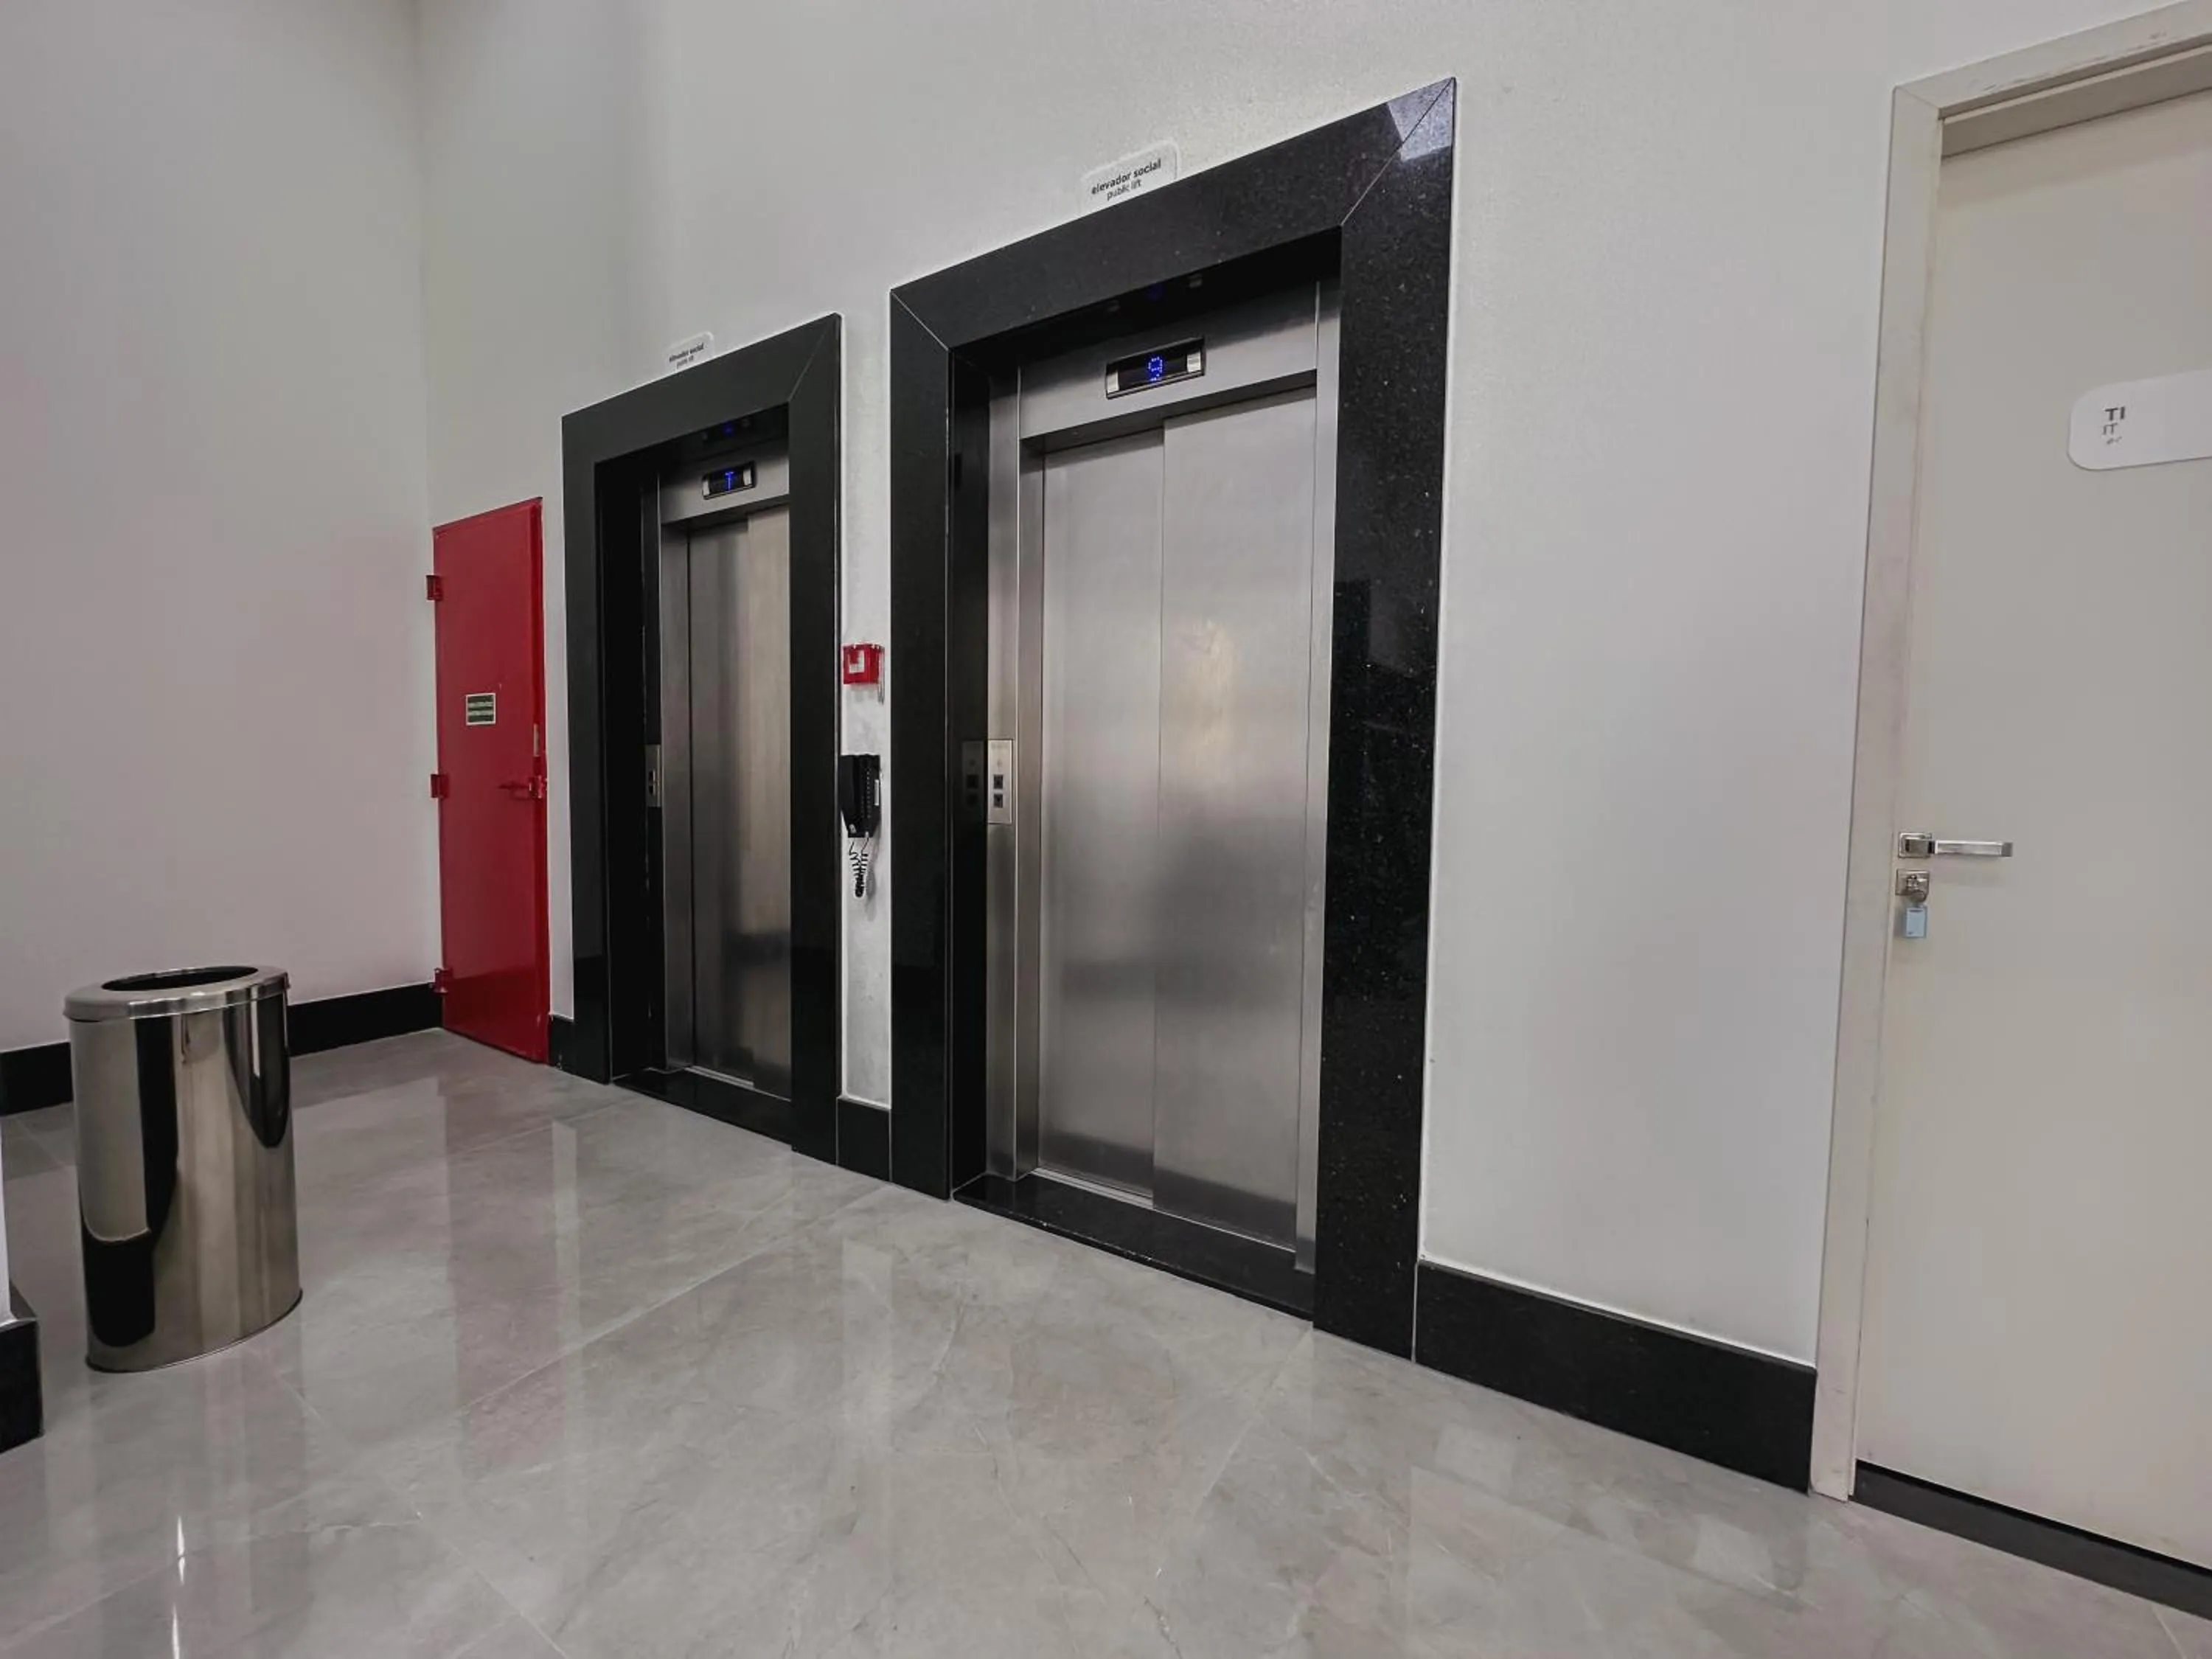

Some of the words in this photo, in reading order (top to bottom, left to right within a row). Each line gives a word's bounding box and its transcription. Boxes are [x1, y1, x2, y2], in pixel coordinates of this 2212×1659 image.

[1091, 172, 1131, 195] elevador
[1133, 158, 1161, 178] social
[1148, 356, 1164, 381] 9
[2104, 406, 2125, 421] TI
